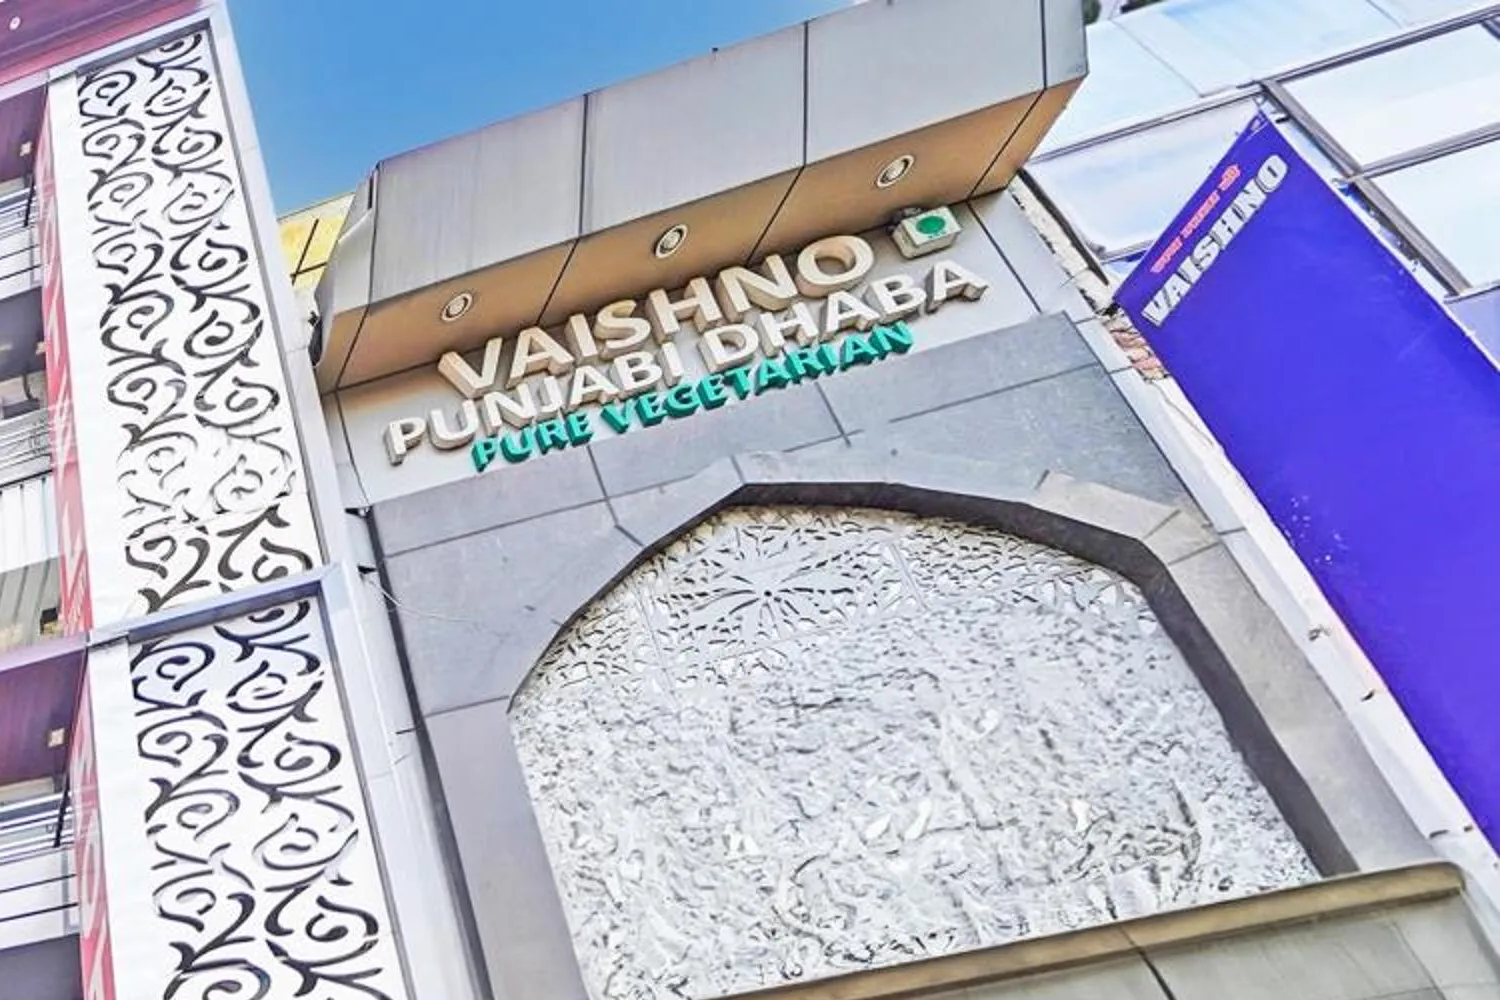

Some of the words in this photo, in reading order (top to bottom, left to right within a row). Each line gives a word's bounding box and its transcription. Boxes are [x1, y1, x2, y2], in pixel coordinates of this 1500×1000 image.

[437, 234, 875, 399] VAISHNO
[1141, 154, 1289, 328] VAISHNO
[385, 341, 683, 466] PUNJABI
[698, 257, 991, 371] DHABA
[470, 408, 594, 473] PURE
[600, 319, 917, 434] VEGETARIAN
